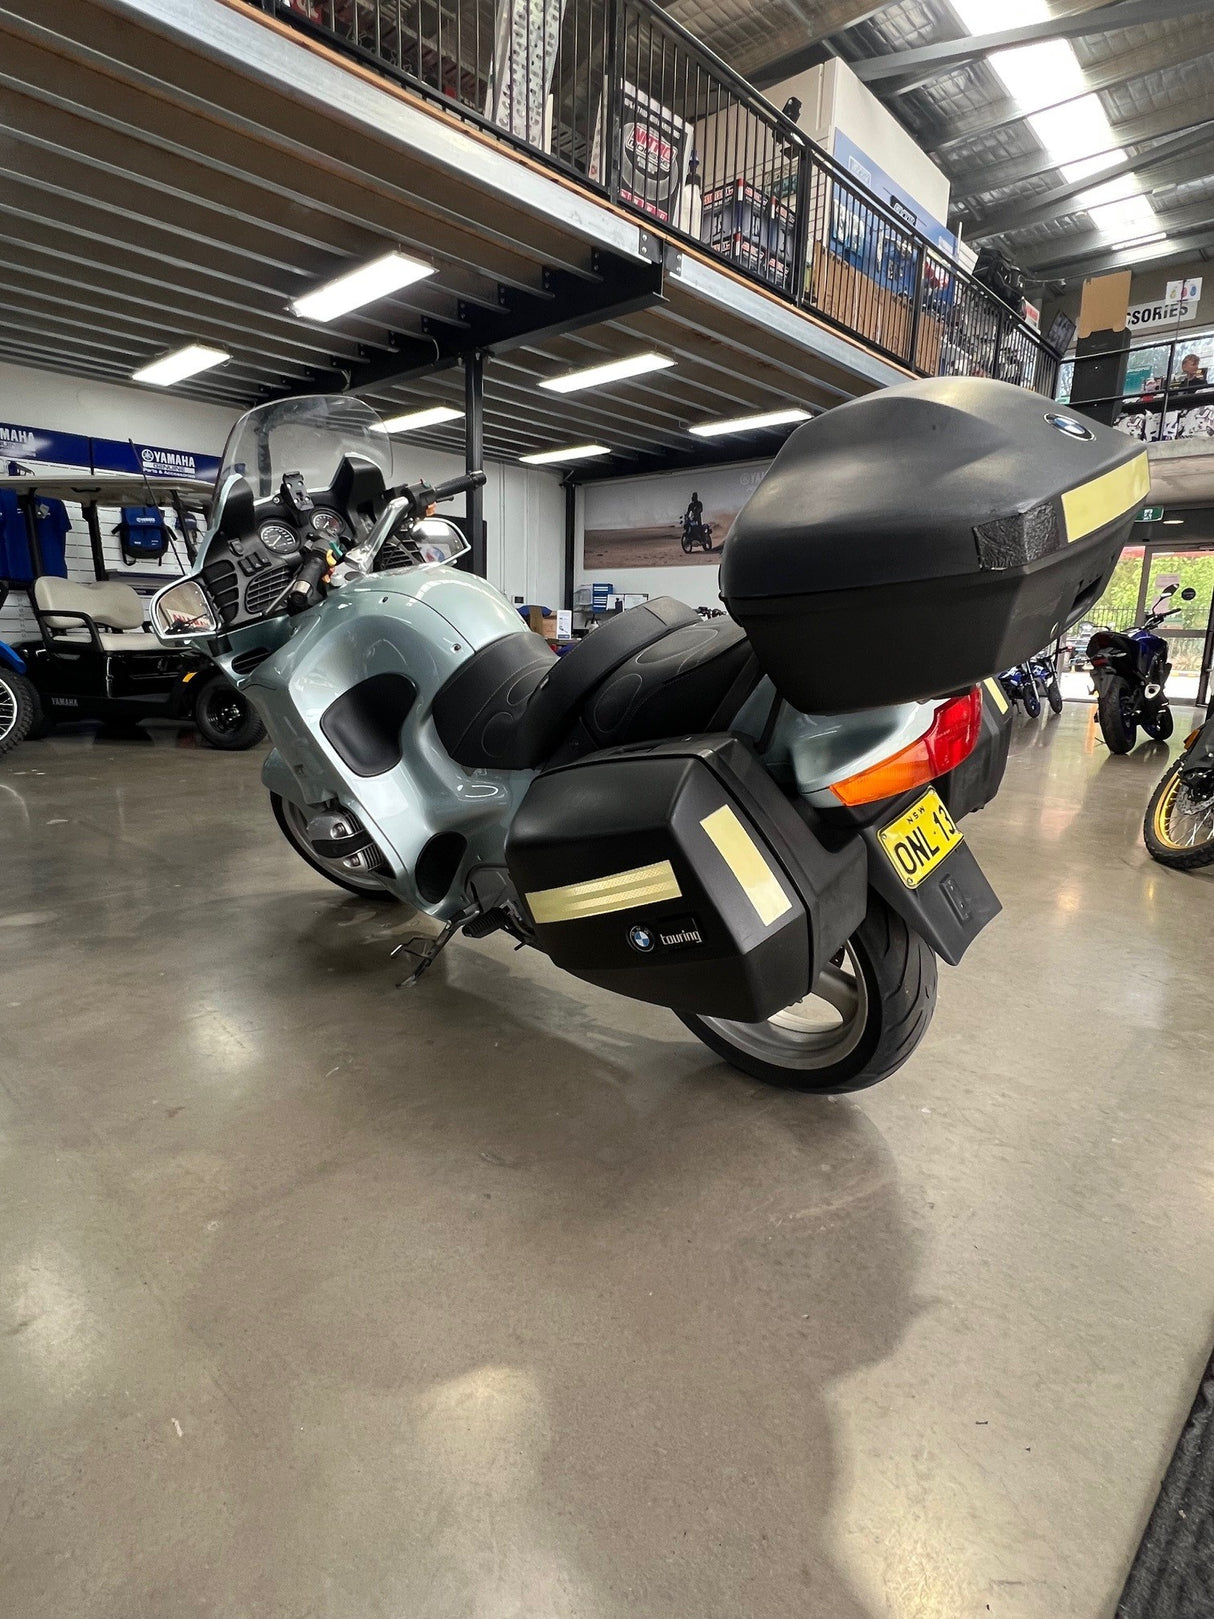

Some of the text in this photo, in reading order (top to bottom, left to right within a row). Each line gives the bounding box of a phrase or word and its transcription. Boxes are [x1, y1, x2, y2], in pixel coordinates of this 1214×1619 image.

[154, 451, 196, 468] YAMAHA
[51, 697, 79, 707] YAMAHA
[907, 806, 926, 825] NSW
[894, 826, 941, 875] ONL
[660, 929, 703, 946] touring
